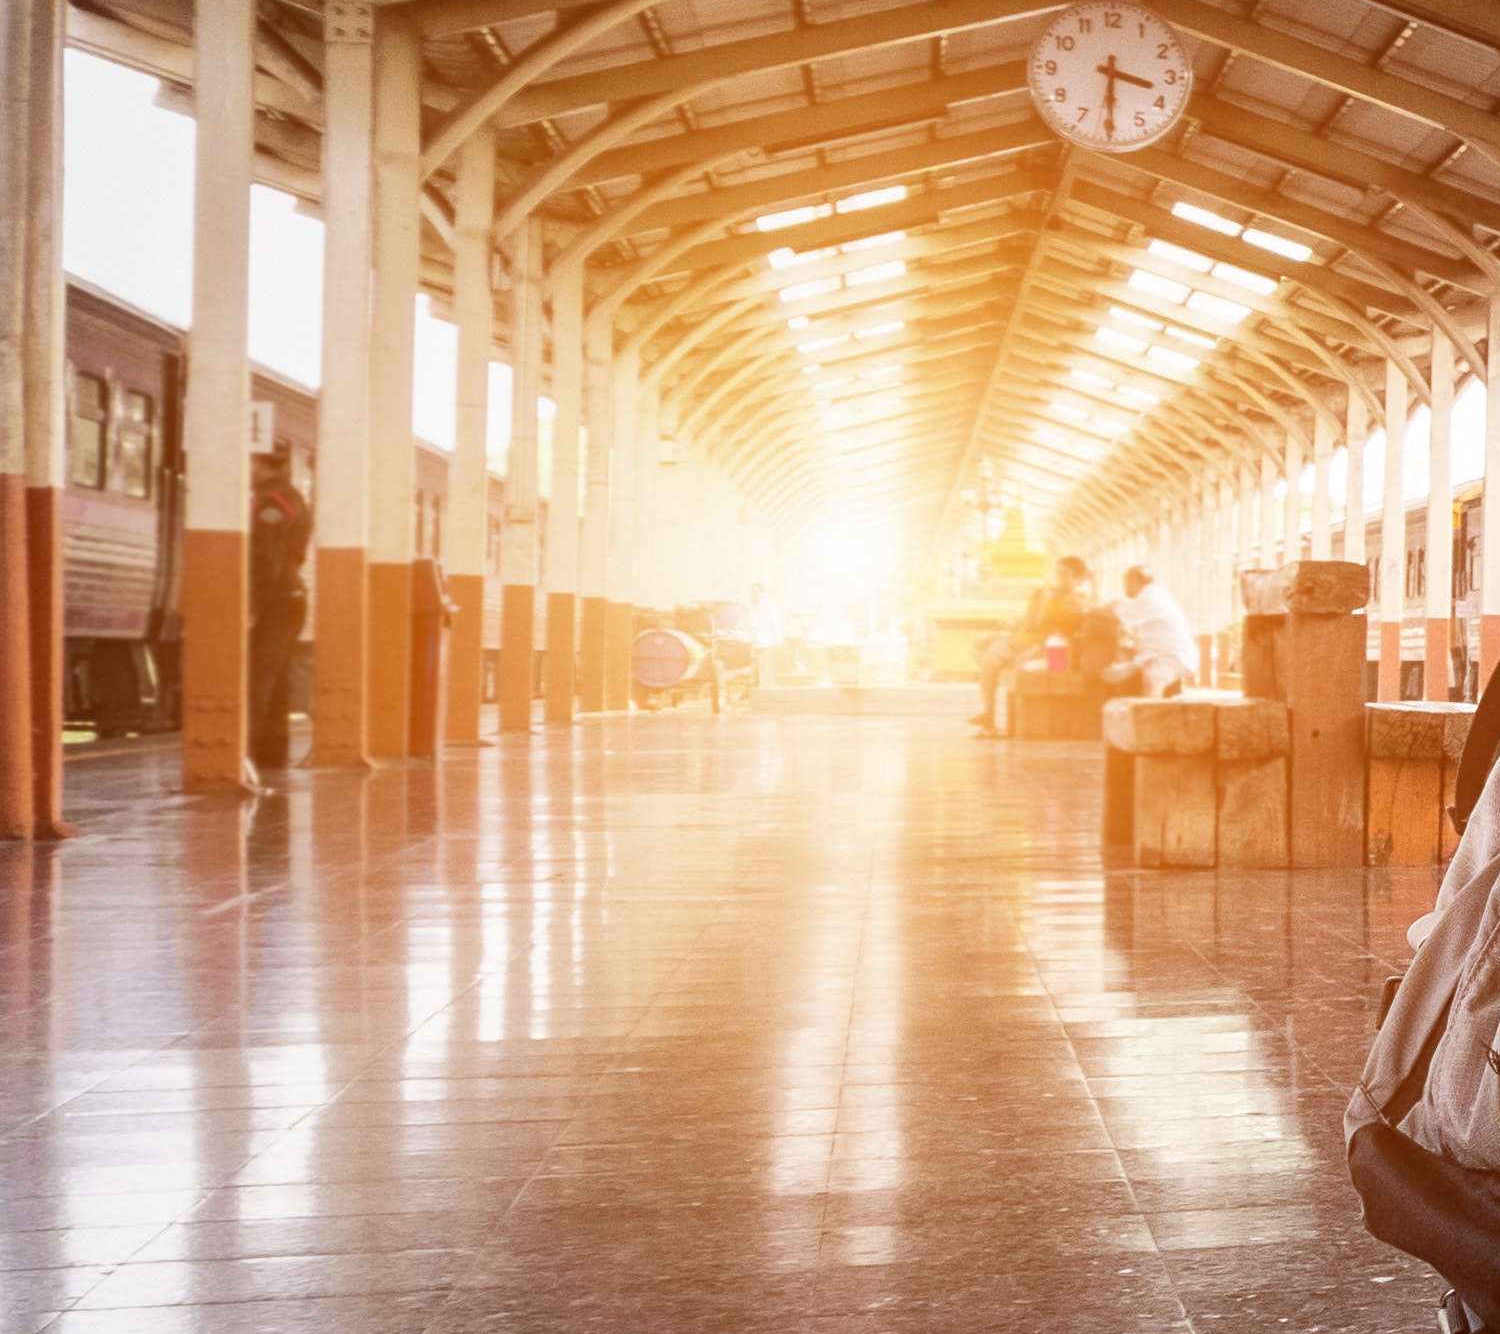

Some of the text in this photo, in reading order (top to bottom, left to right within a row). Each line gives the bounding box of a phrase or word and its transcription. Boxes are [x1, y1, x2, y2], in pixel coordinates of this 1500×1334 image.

[1078, 18, 1091, 34] 11
[1103, 12, 1122, 29] 12
[1138, 22, 1145, 38] 1
[1055, 35, 1075, 51] 10
[1156, 43, 1169, 59] 2
[1044, 60, 1057, 76] 9
[1164, 69, 1177, 85] 3
[1055, 87, 1067, 103] 8
[1153, 95, 1165, 110] 4
[1077, 107, 1089, 123] 7
[1134, 111, 1146, 127] 5
